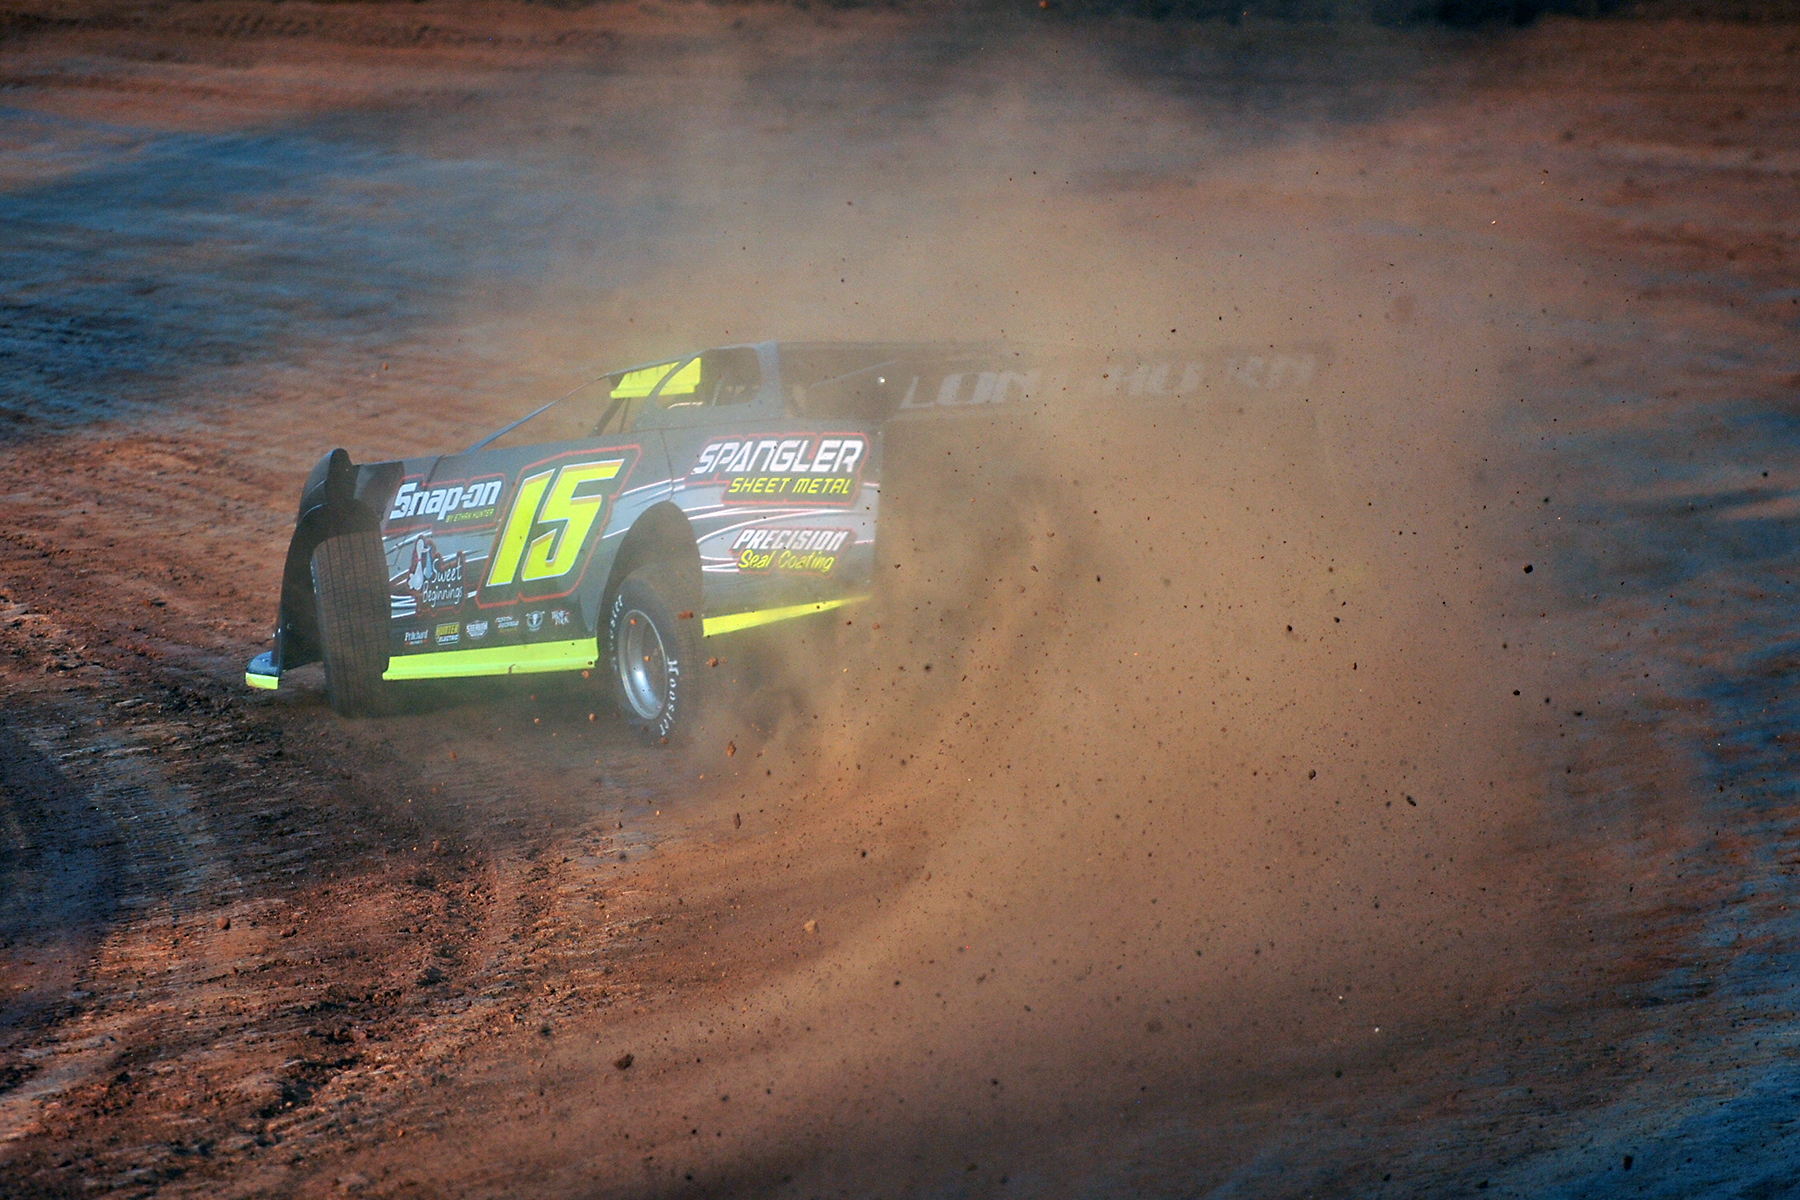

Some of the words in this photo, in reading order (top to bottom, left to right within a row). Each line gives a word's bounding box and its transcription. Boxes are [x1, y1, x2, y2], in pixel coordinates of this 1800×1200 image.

[691, 440, 863, 474] SPANGLER
[728, 477, 791, 493] SHEET
[792, 478, 851, 494] METAL
[389, 480, 502, 520] Snap-on
[486, 459, 624, 587] 15
[733, 529, 849, 550] PRECISION
[431, 556, 462, 583] Sweet
[738, 549, 775, 568] Seal
[778, 551, 835, 573] Coating
[422, 580, 463, 608] Beginnings
